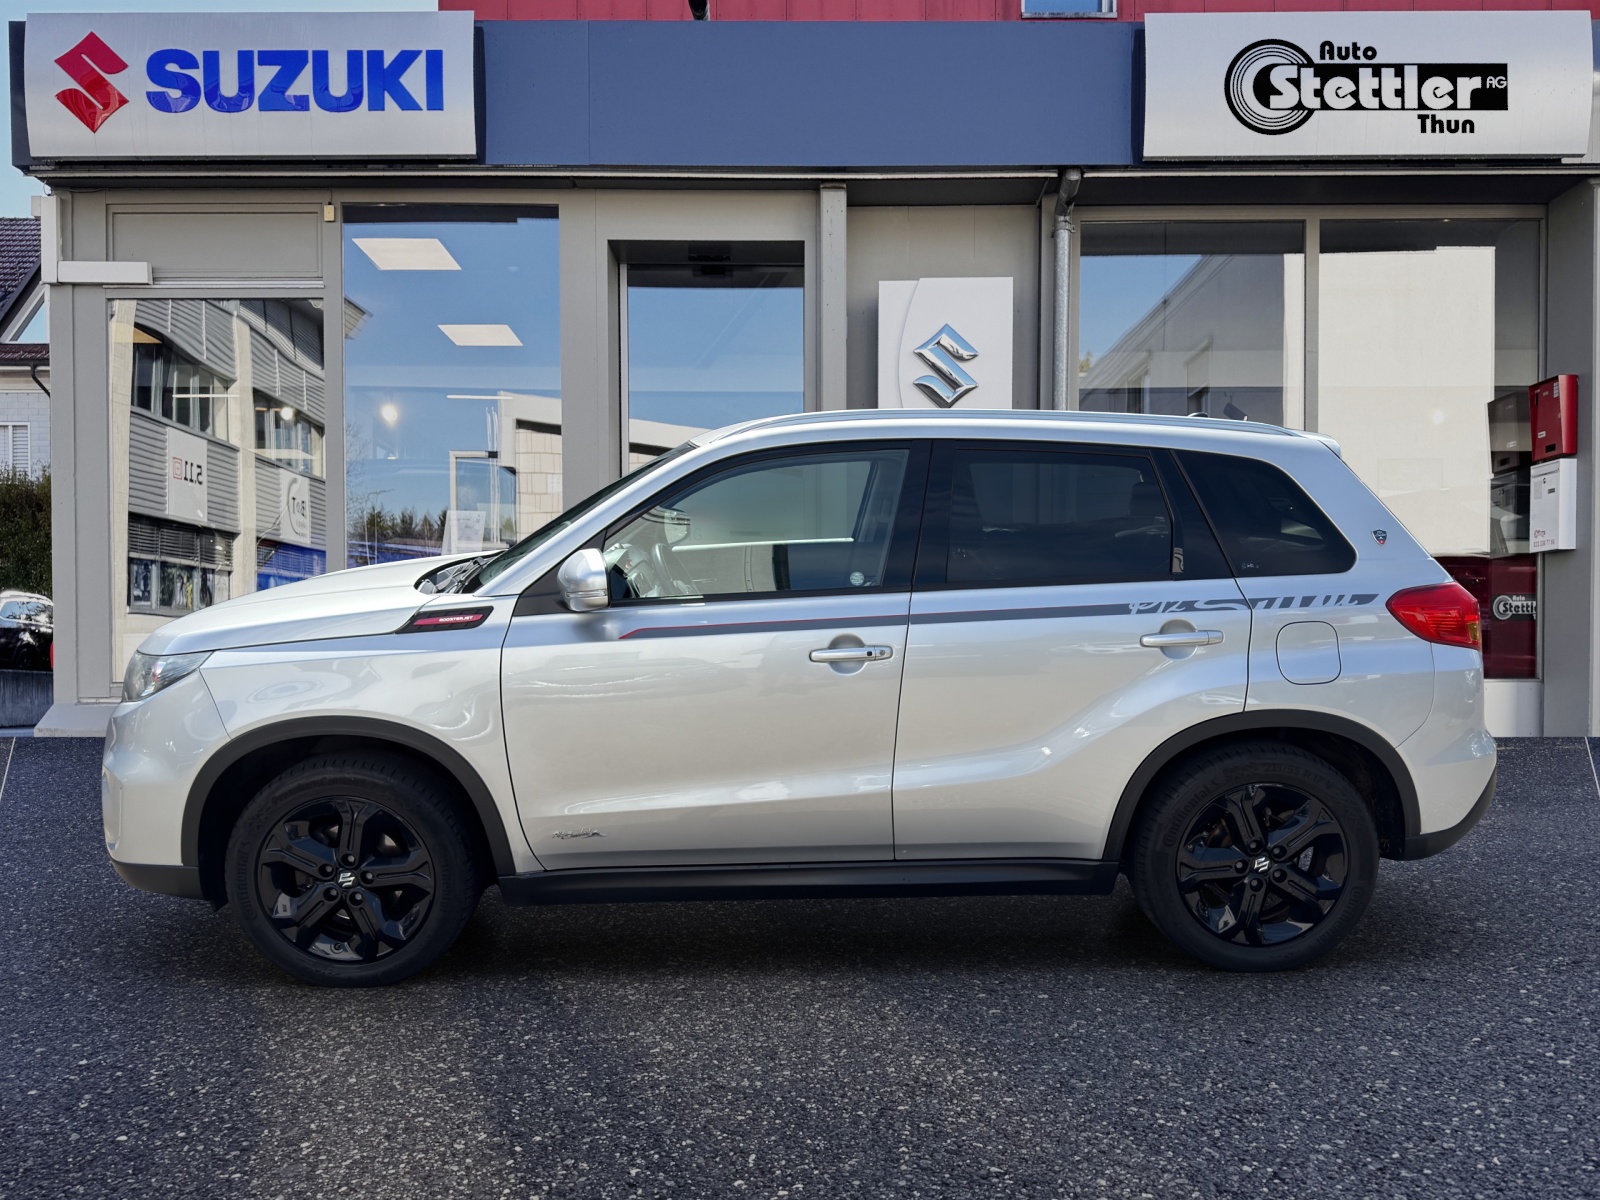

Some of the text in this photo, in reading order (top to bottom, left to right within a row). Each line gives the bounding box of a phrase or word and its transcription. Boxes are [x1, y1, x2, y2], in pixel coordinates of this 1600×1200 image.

[1319, 40, 1377, 61] Auto
[145, 49, 444, 113] SUZUKI
[1269, 65, 1507, 109] Stettler AG
[1417, 113, 1475, 134] Thun
